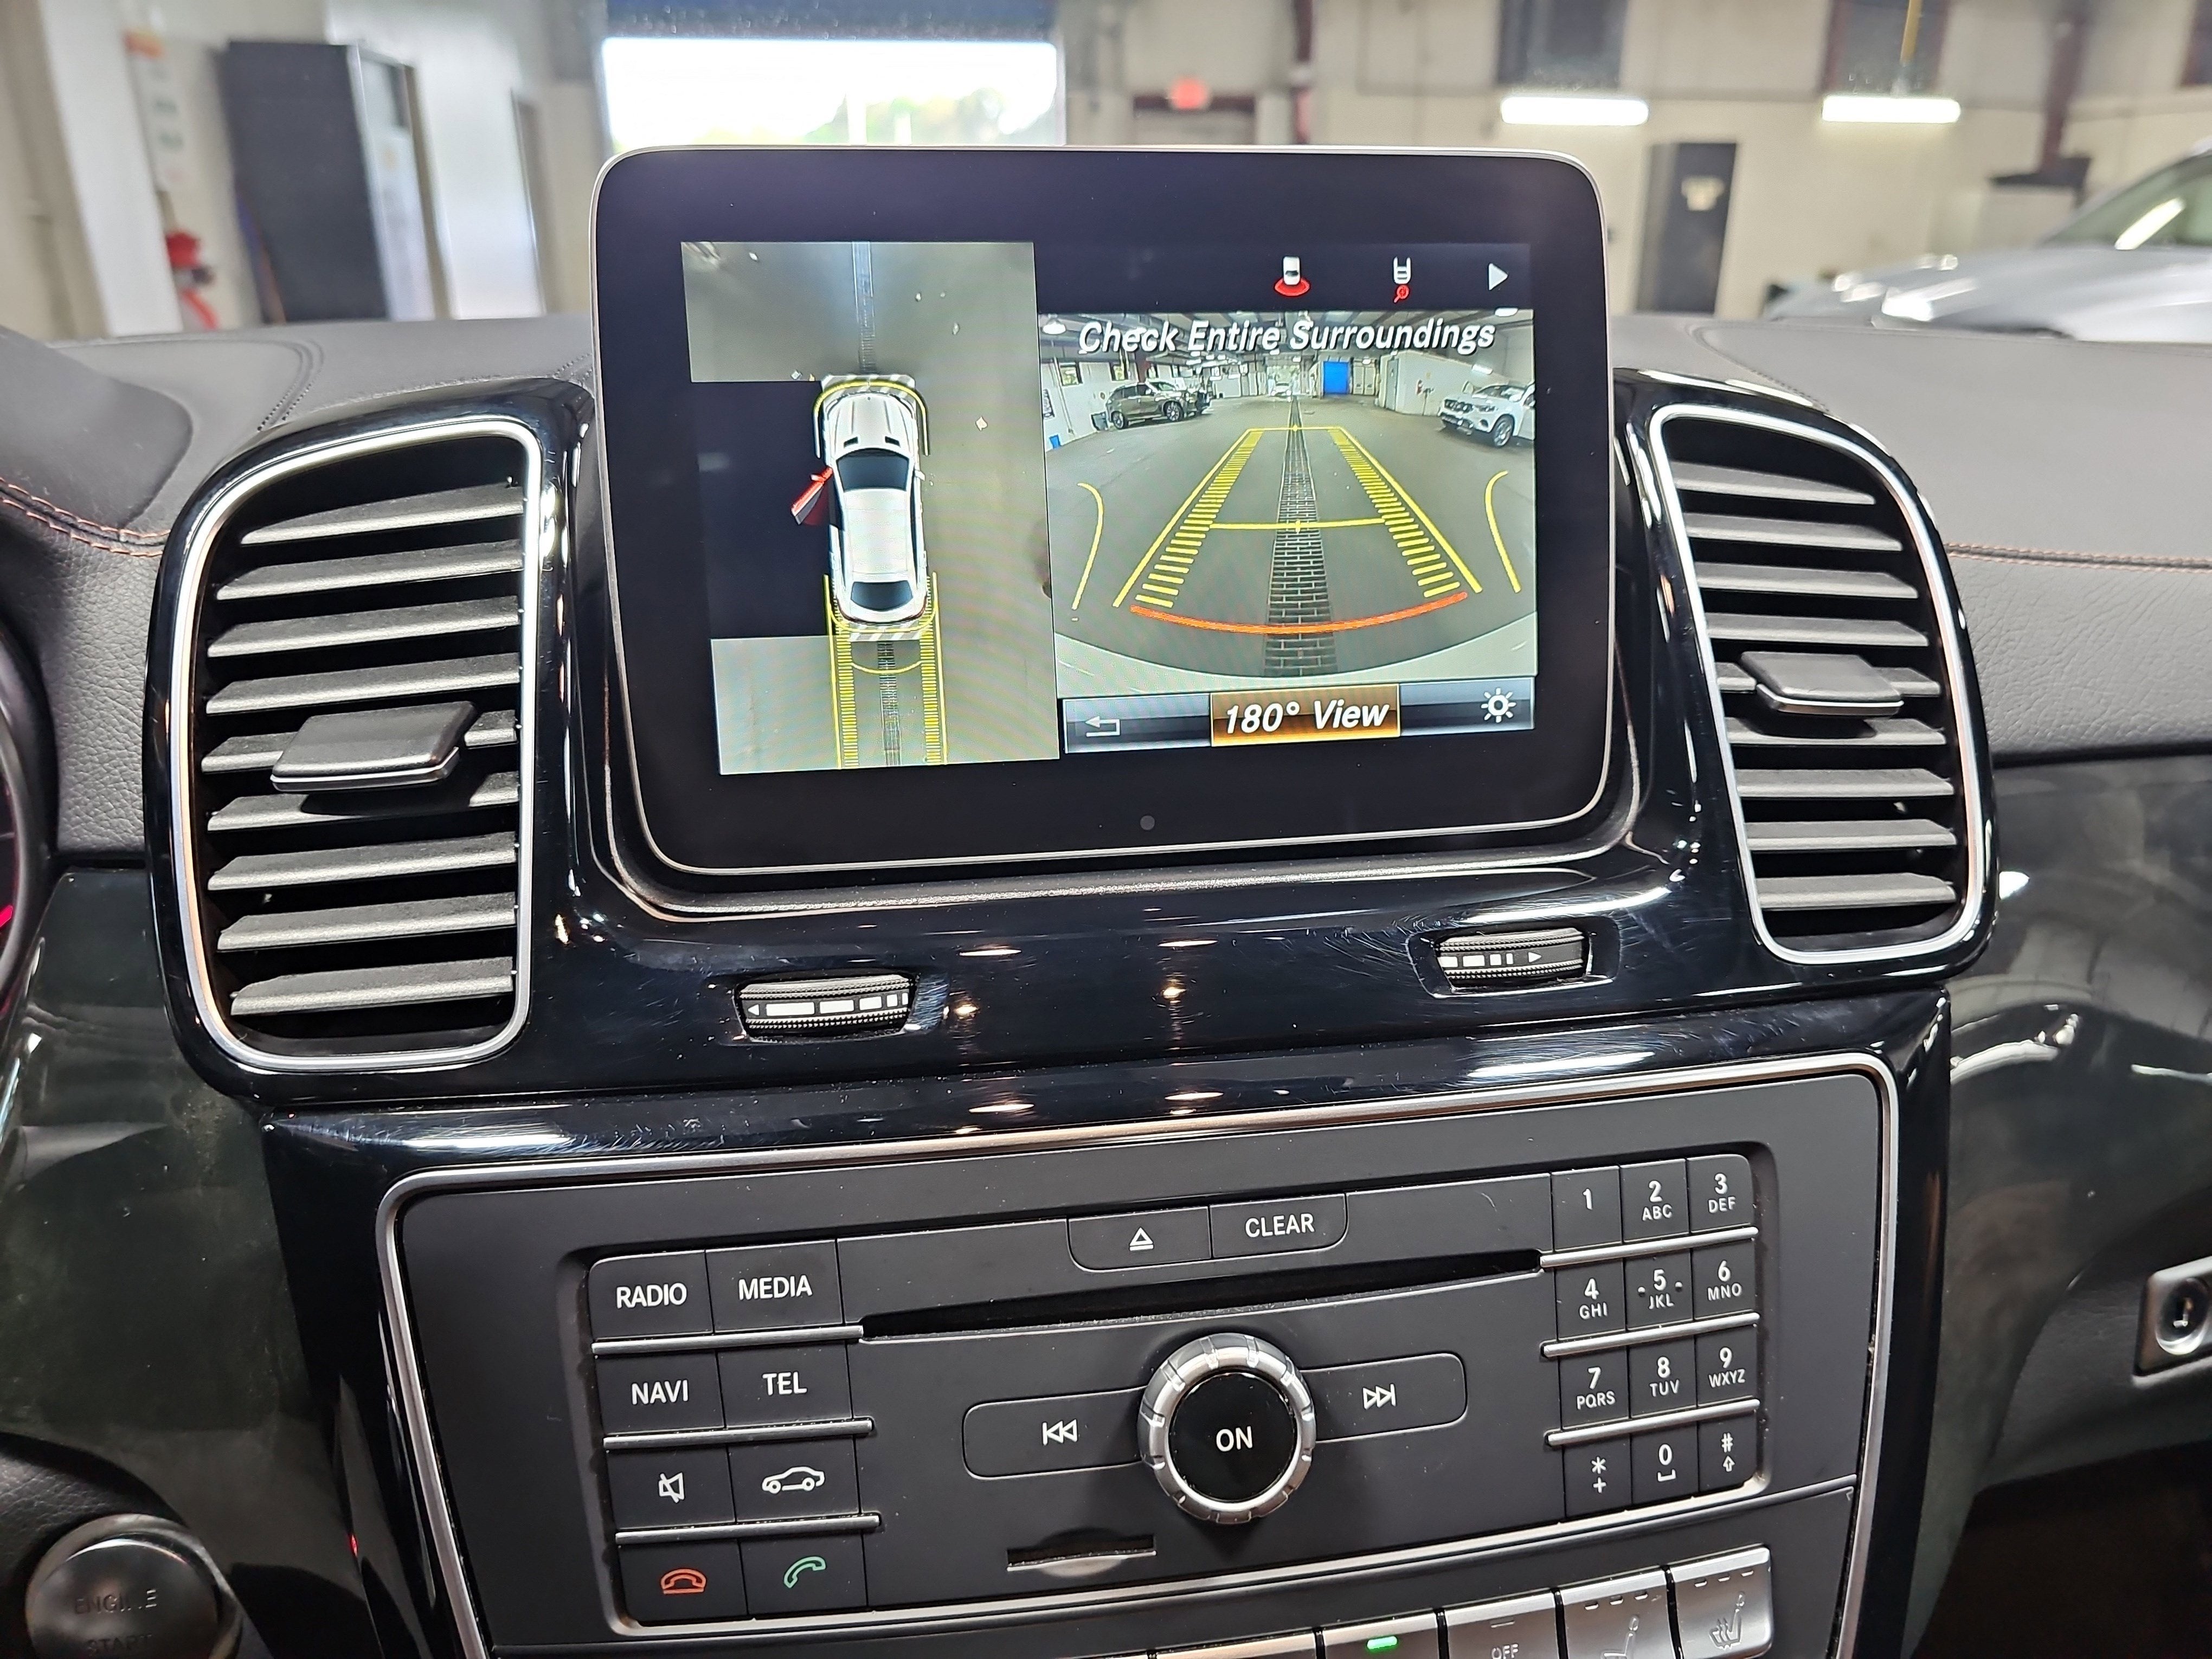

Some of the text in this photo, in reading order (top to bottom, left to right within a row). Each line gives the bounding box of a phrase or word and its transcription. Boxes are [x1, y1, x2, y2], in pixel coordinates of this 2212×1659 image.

[1078, 316, 1496, 355] Check Entire Surroundings
[1314, 699, 1390, 730] View
[1649, 1180, 1662, 1203] 2
[1715, 1173, 1728, 1194] 3
[1583, 1188, 1593, 1210] 1
[1708, 1197, 1735, 1213] DEF
[1642, 1204, 1673, 1221] ABC
[1245, 1213, 1315, 1238] CLEAR
[1654, 1269, 1667, 1291] 5
[1718, 1260, 1731, 1282] 6
[616, 1283, 687, 1309] RADIO
[738, 1275, 813, 1300] MEDIA
[1584, 1278, 1599, 1300] 4
[1708, 1283, 1742, 1301] MNO
[1579, 1302, 1608, 1320] GHI
[1649, 1294, 1674, 1309] JKL
[1657, 1356, 1670, 1378] 8
[1719, 1347, 1732, 1368] 9
[762, 1372, 807, 1396] TEL
[1588, 1367, 1601, 1390] 7
[1649, 1379, 1680, 1397] TUV
[1708, 1368, 1746, 1388] WXYZ
[631, 1380, 689, 1405] NAVI
[1577, 1391, 1616, 1410] PQRS
[1216, 1426, 1253, 1452] ON
[1658, 1444, 1673, 1466] 0
[75, 1589, 157, 1615] ENGIE
[1491, 1644, 1519, 1659] OFF
